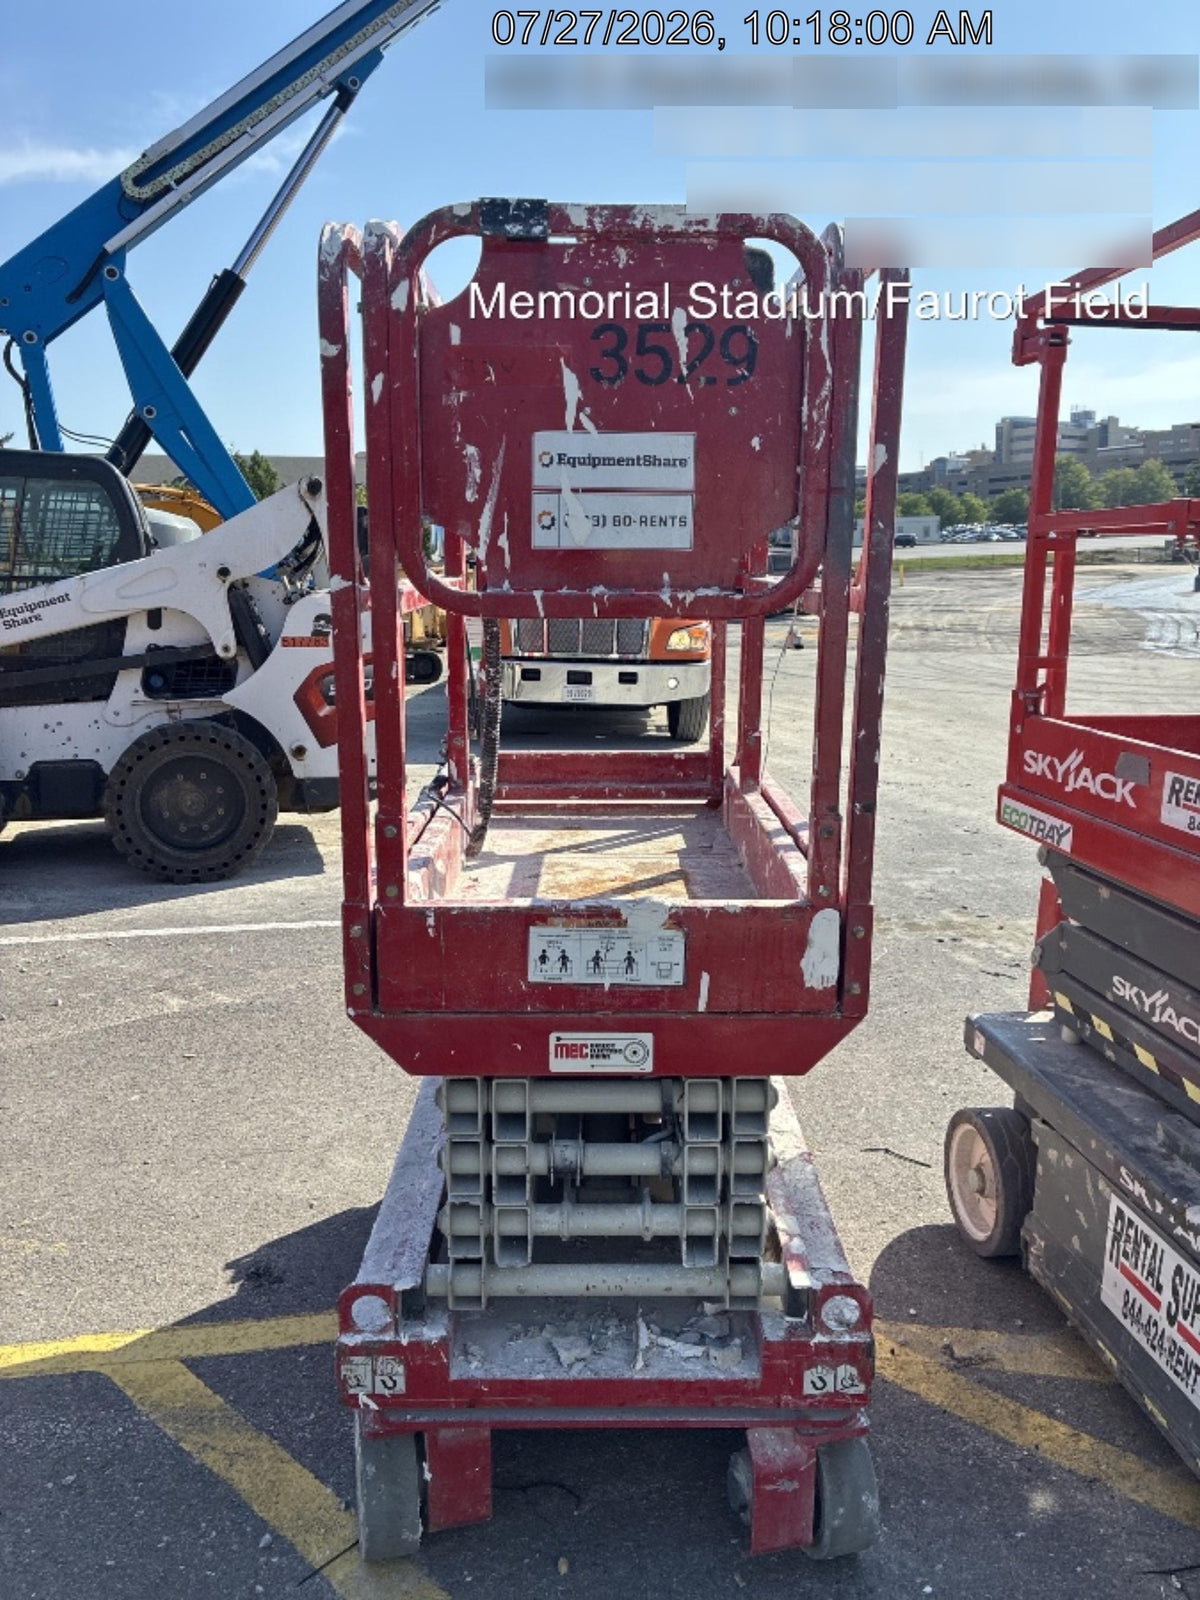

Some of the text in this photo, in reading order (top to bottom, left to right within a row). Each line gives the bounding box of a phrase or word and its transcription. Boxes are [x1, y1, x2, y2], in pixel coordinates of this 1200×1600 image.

[589, 323, 759, 386] 3529
[557, 453, 688, 469] EquipmentShare
[0, 593, 71, 618] Equipment
[3, 613, 42, 630] Share
[1023, 748, 1137, 808] SKYJACK
[1002, 804, 1071, 846] ECOTRAY
[1112, 975, 1200, 1045] SKYJAC
[554, 1043, 589, 1060] MEC
[1110, 1205, 1165, 1298] RENTAL
